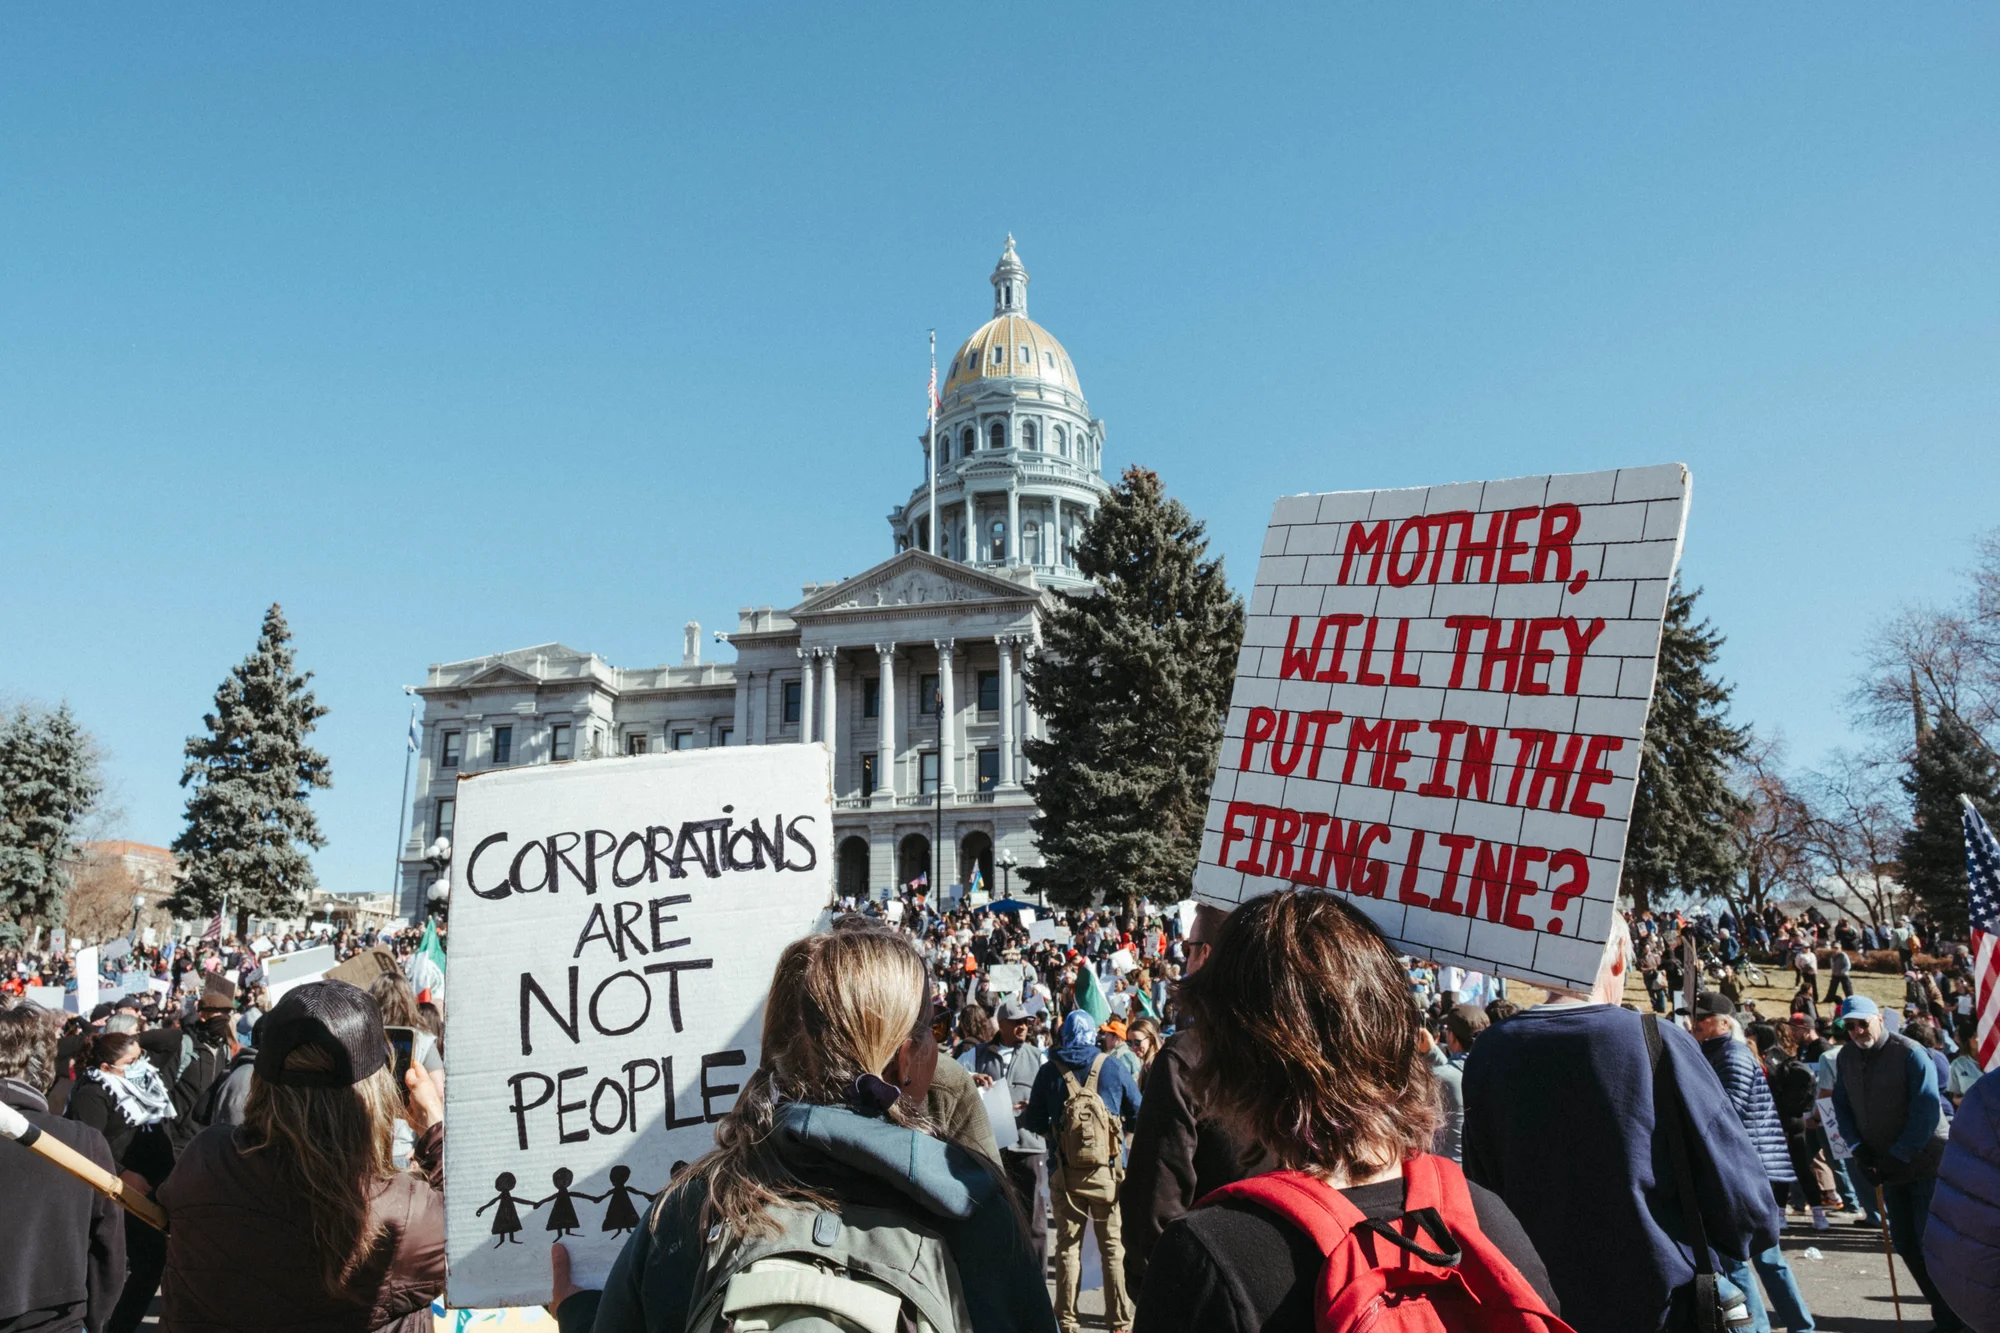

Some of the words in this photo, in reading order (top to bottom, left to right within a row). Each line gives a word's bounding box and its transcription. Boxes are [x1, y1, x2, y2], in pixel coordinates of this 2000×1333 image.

[1338, 504, 1588, 594] MOTHER,
[1280, 614, 1420, 687] WILL
[1446, 616, 1605, 695] THEY
[1240, 707, 1342, 778] PUT
[1342, 718, 1420, 791] ME
[1418, 720, 1498, 800] IN
[1507, 729, 1623, 817] THE
[1219, 802, 1390, 897] FIRING
[1400, 831, 1589, 933] LINE?
[574, 894, 692, 962] ARE
[520, 958, 713, 1056] NOT
[508, 1050, 746, 1150] PEOPLE
